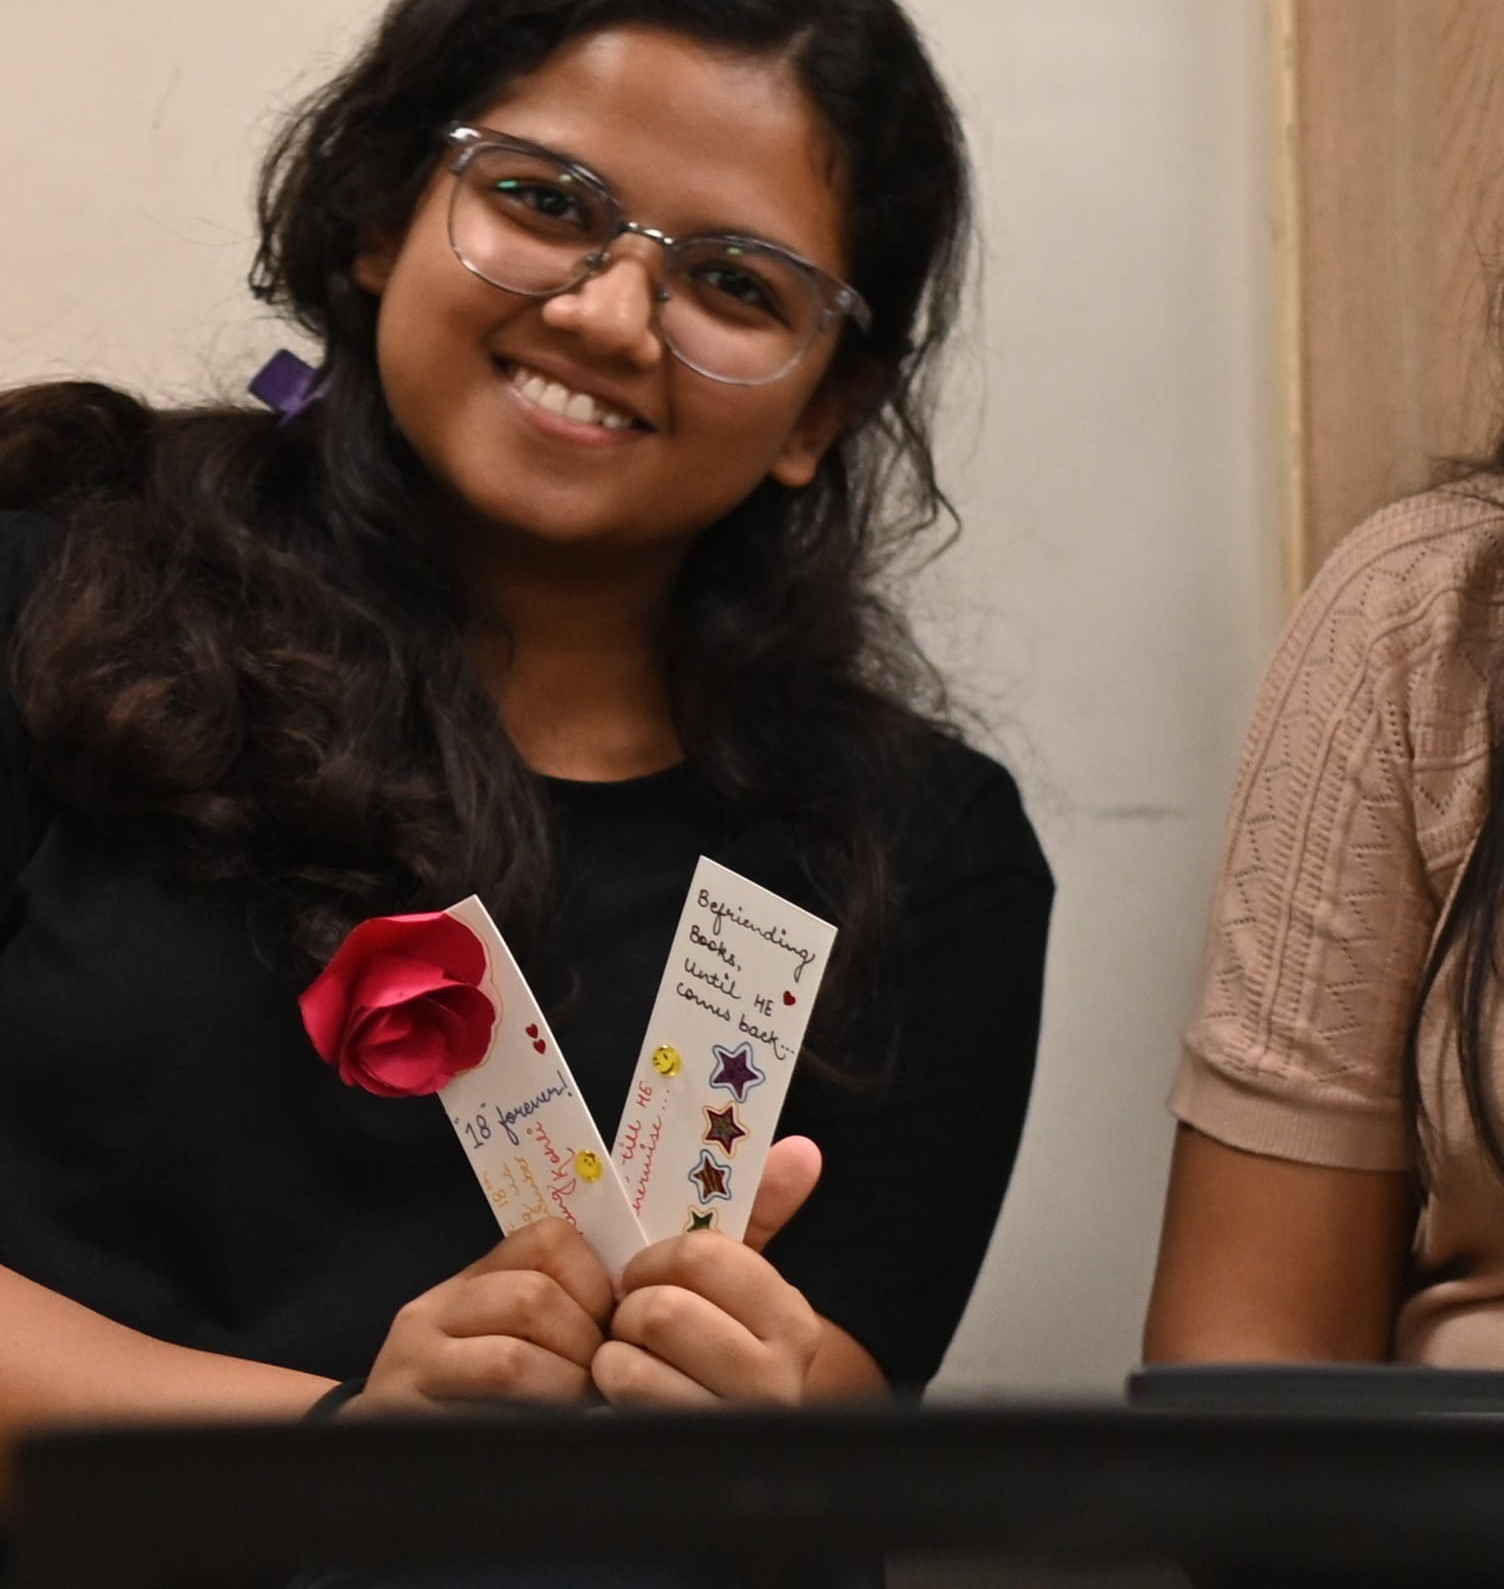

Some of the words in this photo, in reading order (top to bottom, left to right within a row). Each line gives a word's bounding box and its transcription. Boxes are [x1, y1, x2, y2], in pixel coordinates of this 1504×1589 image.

[697, 888, 816, 984] Befriending
[683, 957, 742, 1000] Until
[753, 993, 775, 1018] HE
[495, 1070, 573, 1147] forever!
